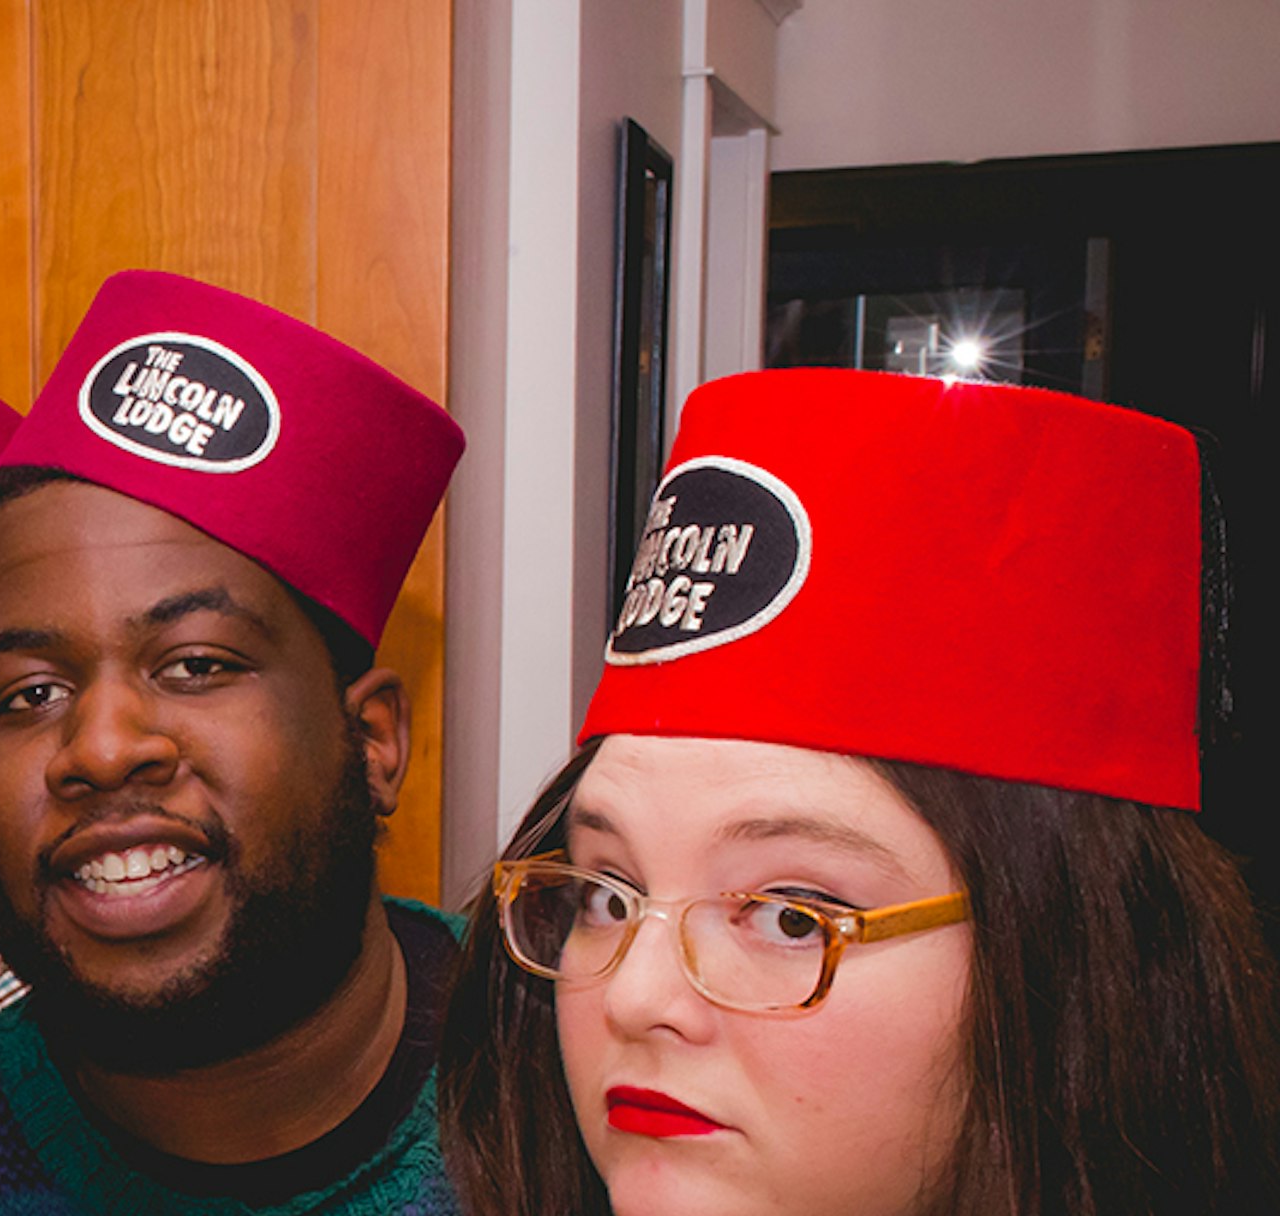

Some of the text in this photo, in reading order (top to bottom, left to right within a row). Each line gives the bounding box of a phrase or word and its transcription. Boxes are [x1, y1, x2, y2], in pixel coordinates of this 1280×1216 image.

[145, 345, 184, 373] THE
[112, 396, 214, 456] LODGE
[113, 361, 245, 431] LINCOLN
